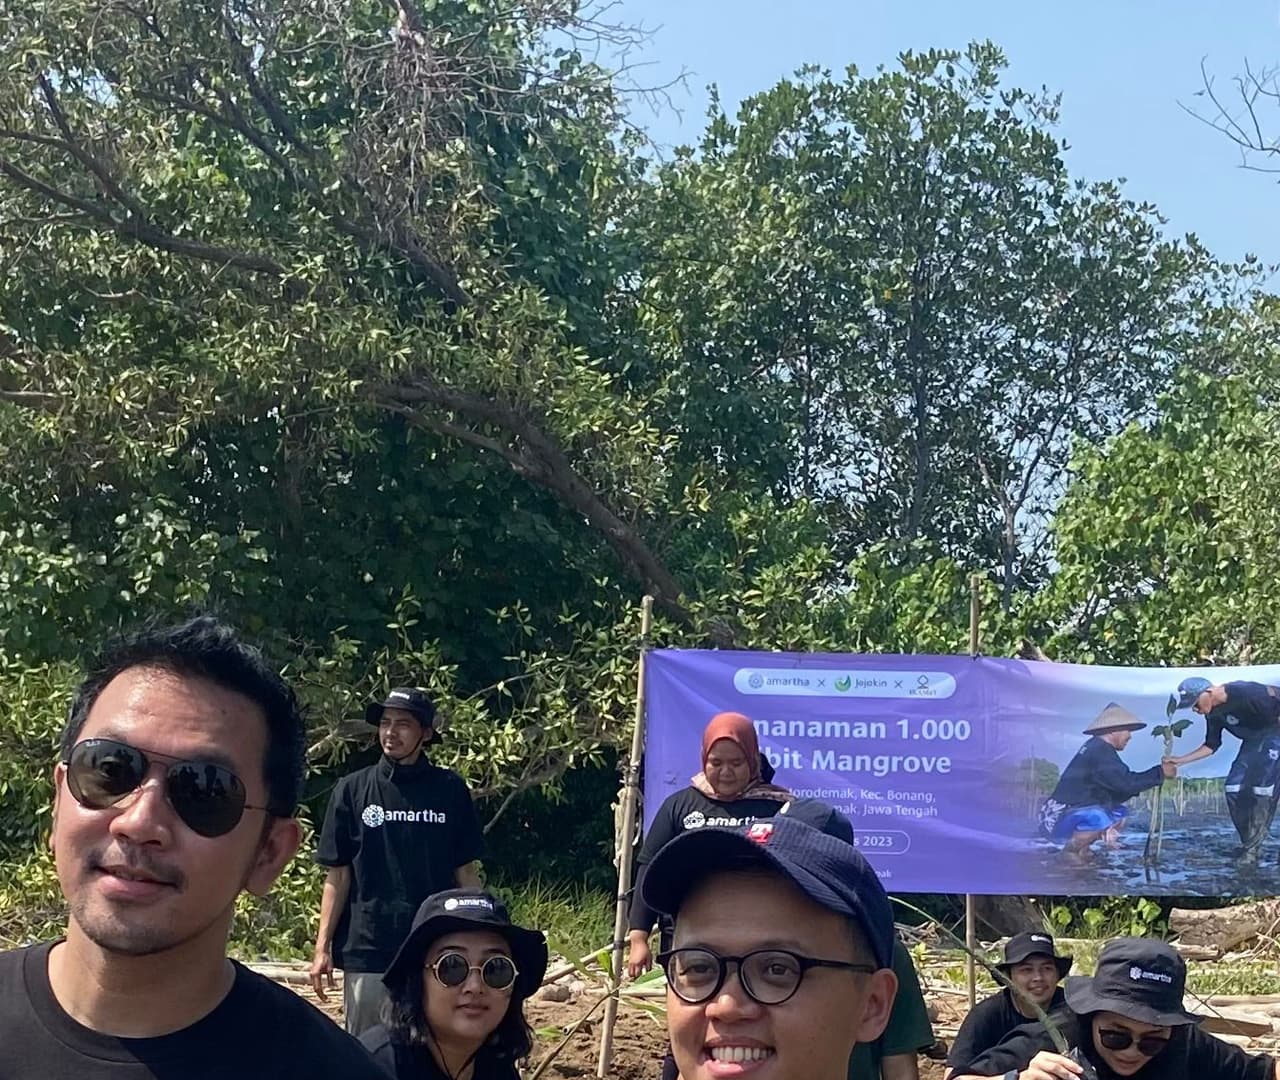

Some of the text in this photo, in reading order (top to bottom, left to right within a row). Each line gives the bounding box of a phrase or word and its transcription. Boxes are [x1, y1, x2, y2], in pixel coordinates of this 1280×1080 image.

[766, 676, 810, 687] amartha
[753, 719, 971, 740] nanaman 1.000
[759, 746, 952, 777] bit Mangrove
[860, 788, 884, 800] Kec.
[887, 789, 936, 803] Bonang,
[385, 808, 446, 824] amartha
[862, 803, 892, 817] Jawa
[896, 804, 938, 818] Tengah
[863, 835, 893, 847] 2023
